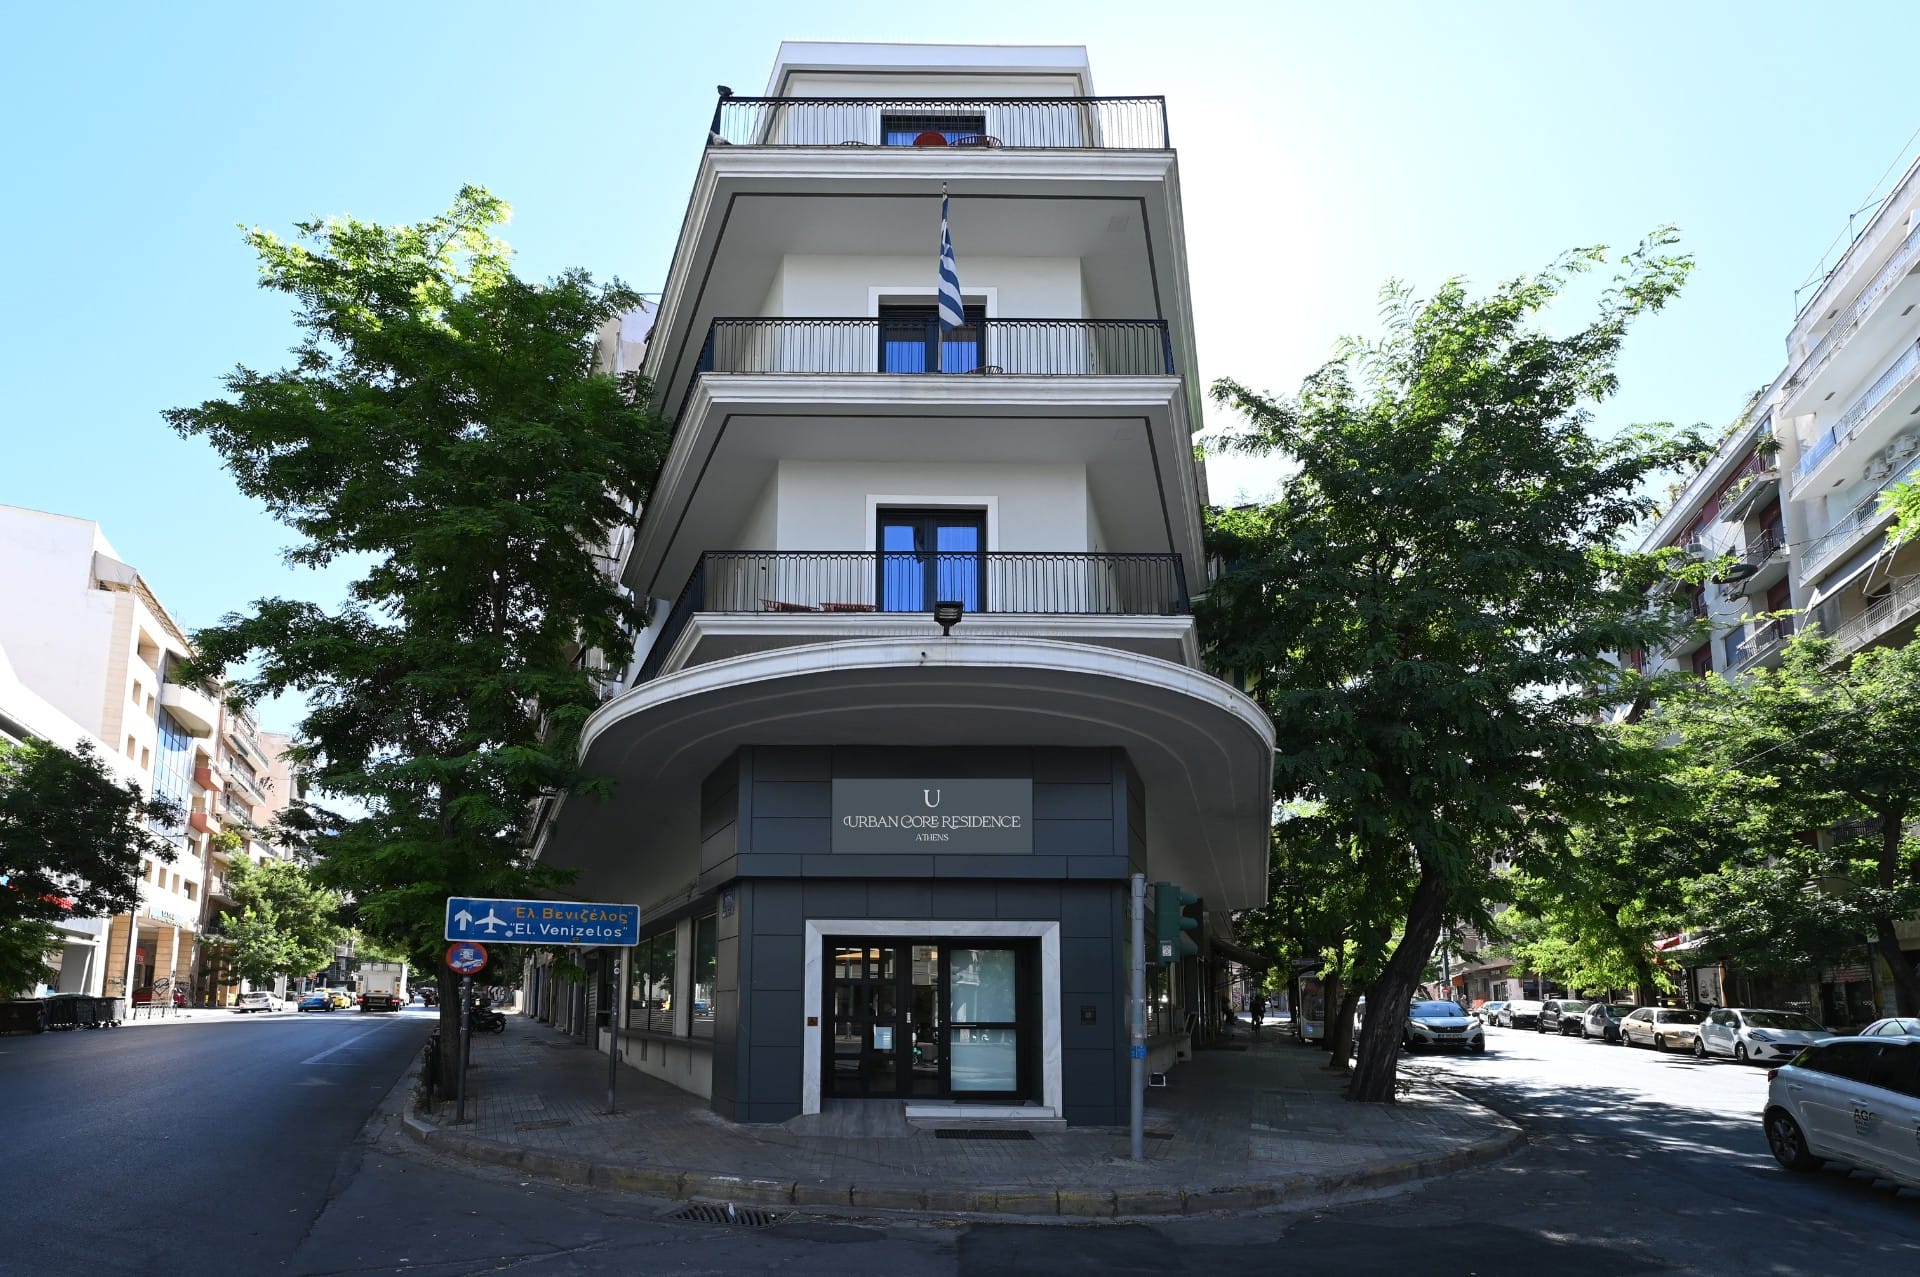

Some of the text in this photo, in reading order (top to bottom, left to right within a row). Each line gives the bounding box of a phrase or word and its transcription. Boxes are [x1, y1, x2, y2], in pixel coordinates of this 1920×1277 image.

[923, 789, 941, 808] U
[843, 814, 1021, 830] URBAN CORE RESIDENCE
[915, 833, 949, 842] ATHENS
